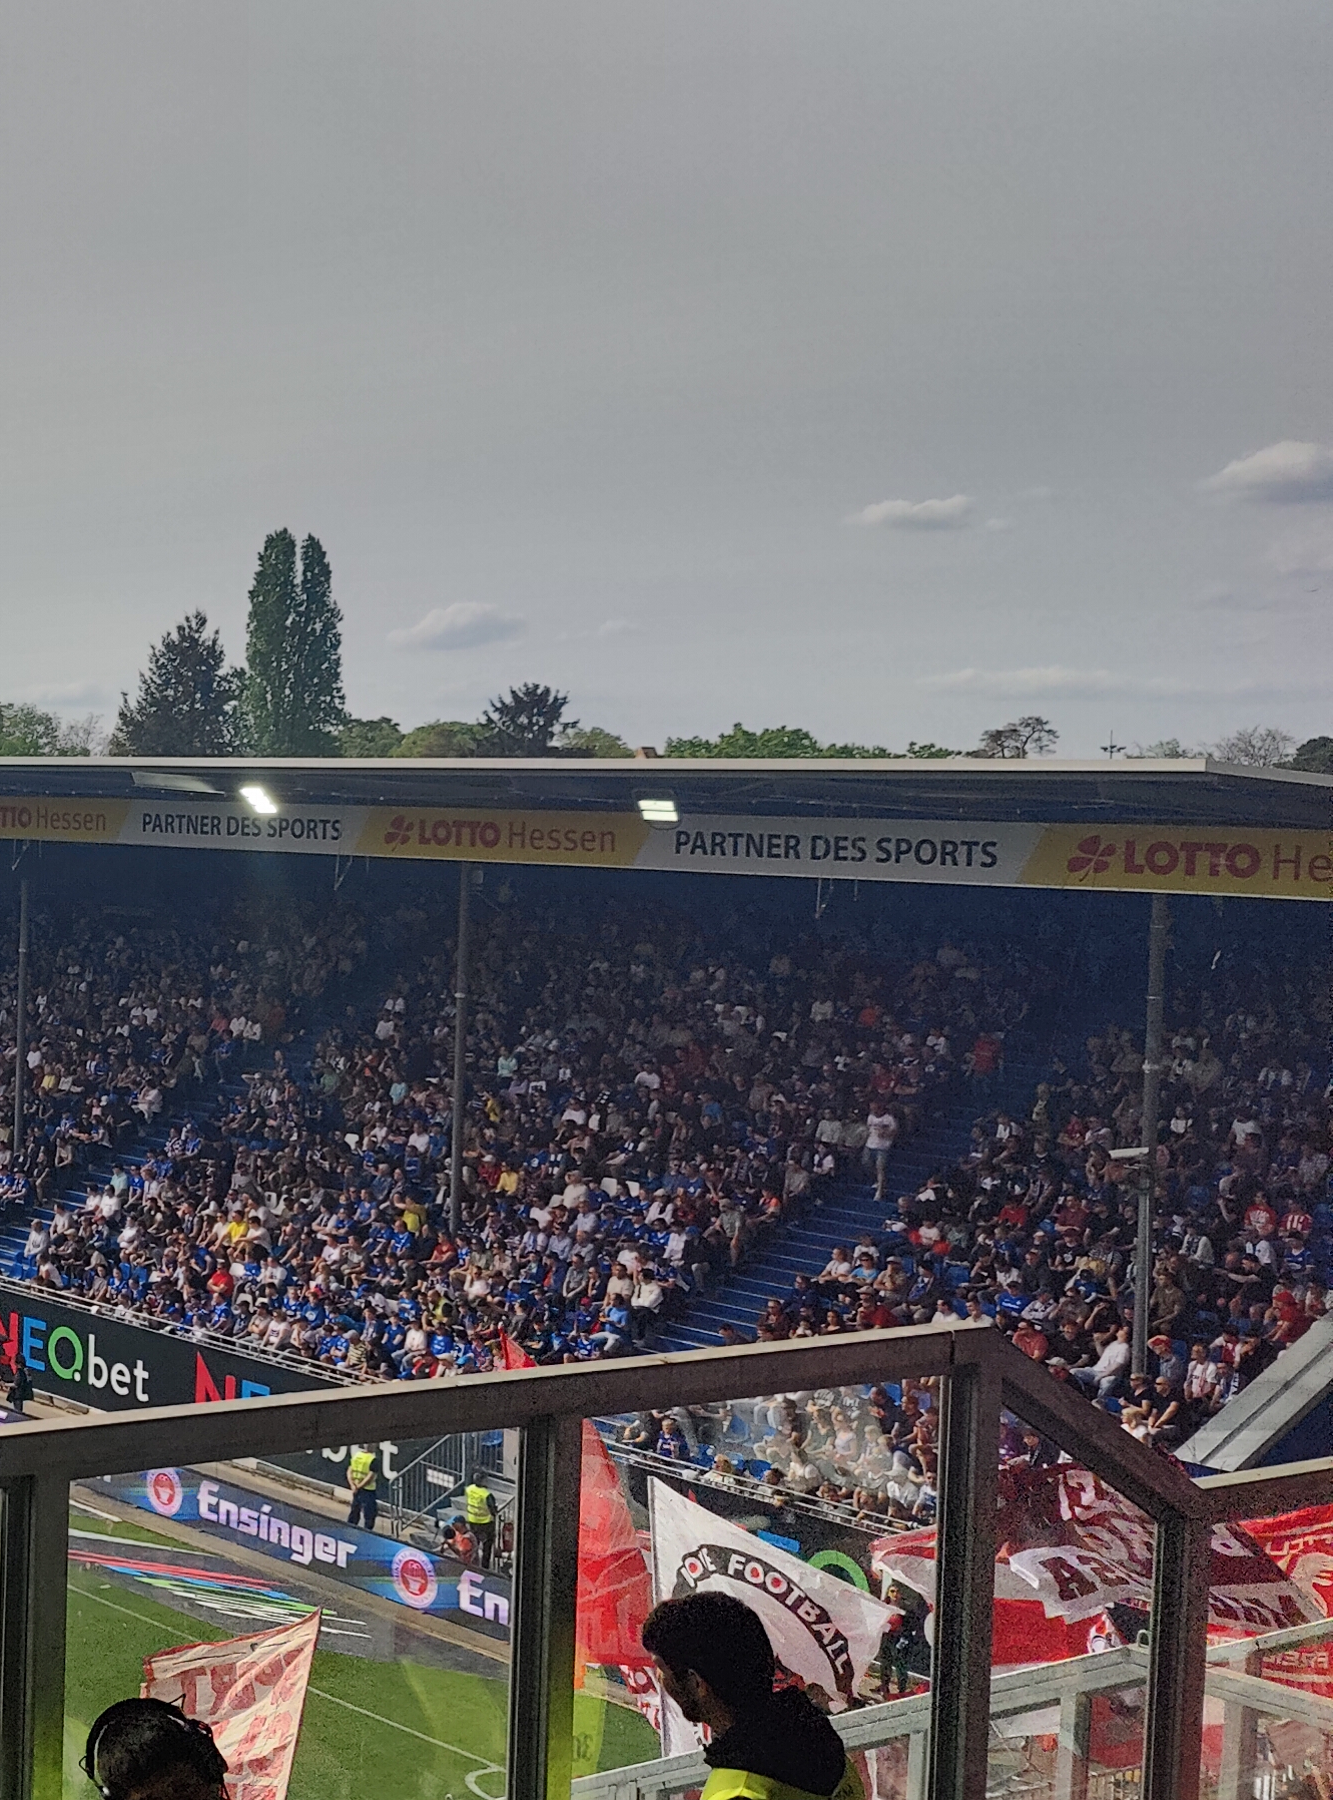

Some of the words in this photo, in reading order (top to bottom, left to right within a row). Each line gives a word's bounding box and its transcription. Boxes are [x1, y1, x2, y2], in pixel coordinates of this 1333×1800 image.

[36, 807, 107, 831] Hessen
[142, 814, 221, 837] PARTNER
[227, 817, 261, 838] DES
[267, 818, 342, 841] SPORTS
[418, 820, 501, 849] LOTTO
[508, 822, 615, 853] Hessen
[675, 830, 801, 860] PARTNER
[809, 834, 867, 863] DES
[875, 836, 998, 868] SPORTS
[1125, 840, 1261, 879] LOTTO
[196, 1480, 358, 1568] Ensinger
[727, 1553, 846, 1676] FOOTBALL
